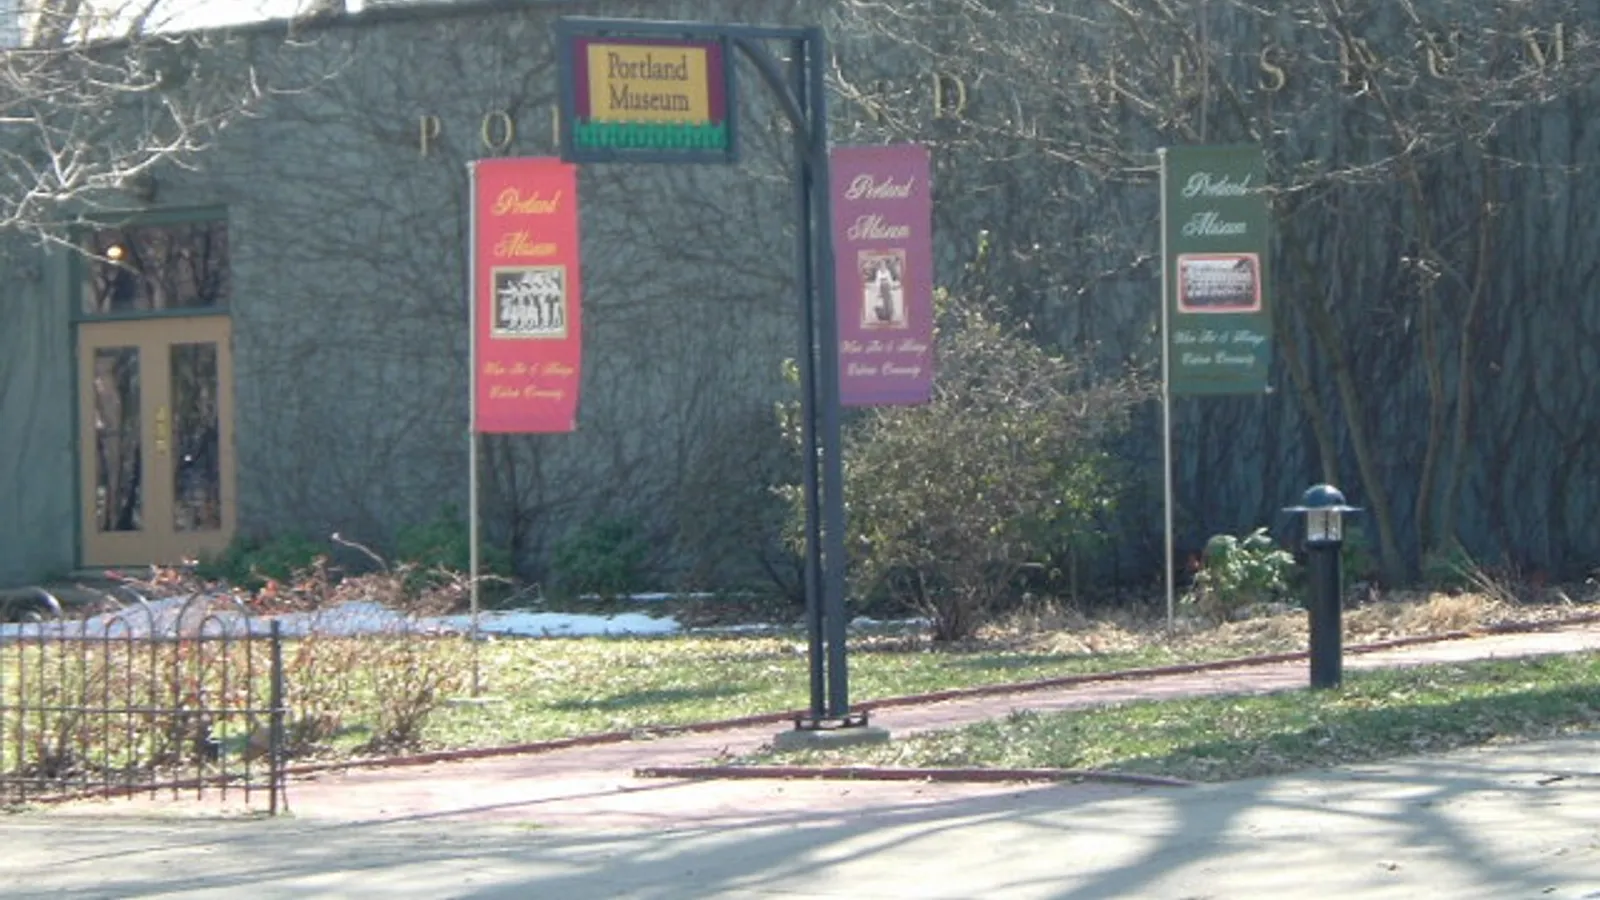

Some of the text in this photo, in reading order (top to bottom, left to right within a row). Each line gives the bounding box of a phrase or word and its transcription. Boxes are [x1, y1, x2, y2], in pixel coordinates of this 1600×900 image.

[608, 51, 689, 80] Portland
[609, 84, 690, 111] Museum
[491, 186, 562, 216] Portland
[844, 173, 915, 201] Portland
